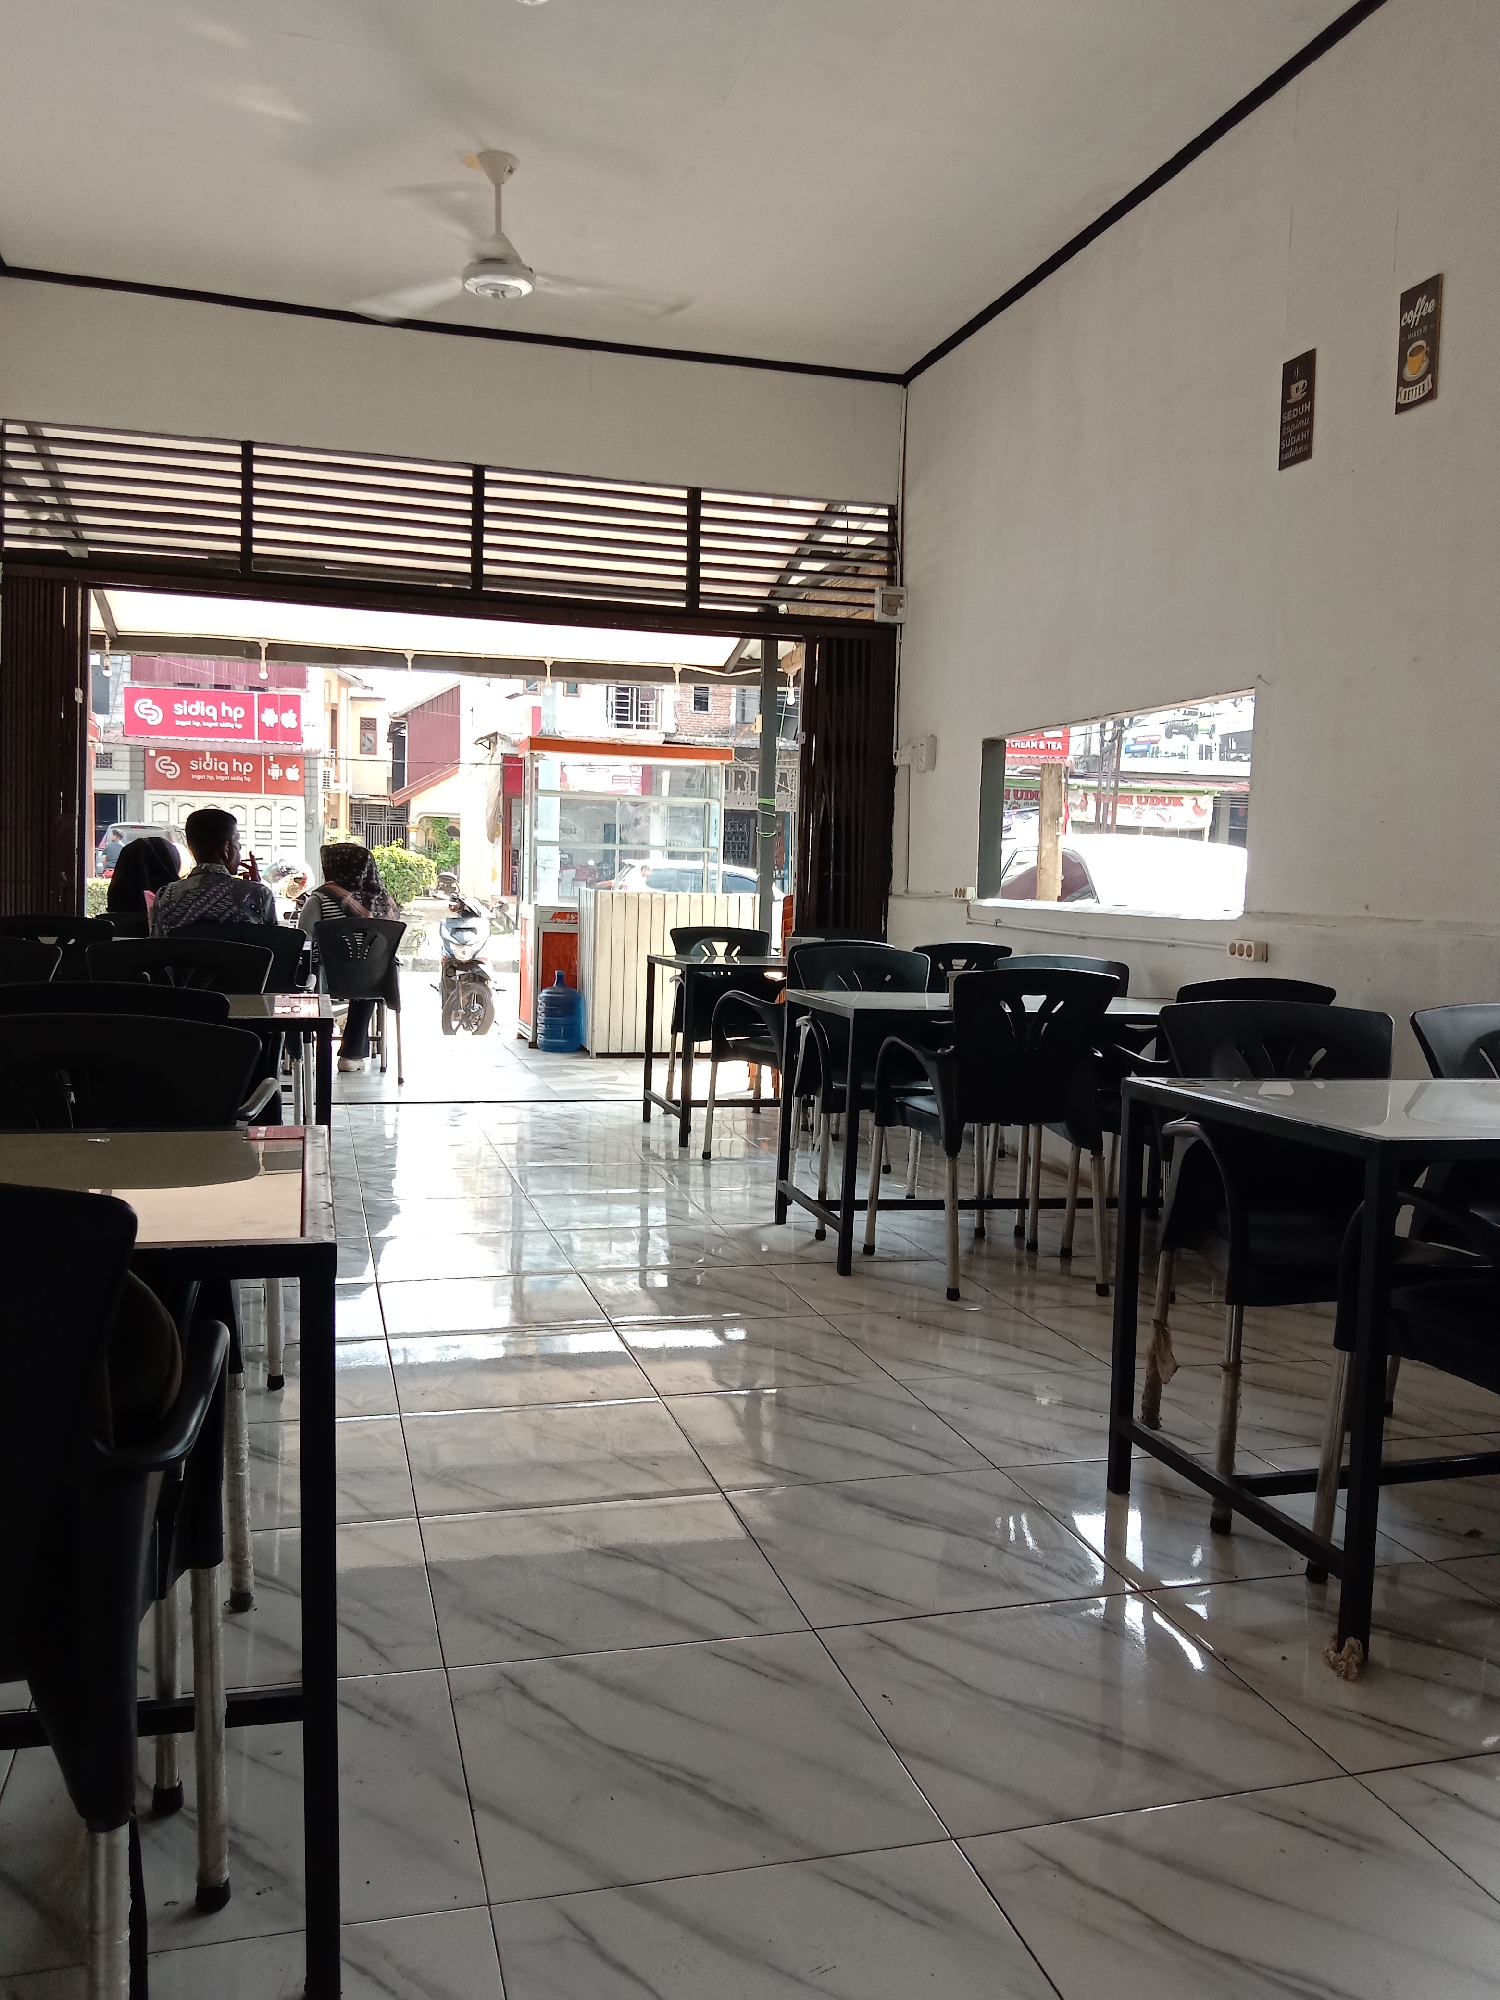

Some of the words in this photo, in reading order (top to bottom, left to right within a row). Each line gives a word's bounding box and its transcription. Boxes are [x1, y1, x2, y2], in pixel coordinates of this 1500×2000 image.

[1401, 294, 1436, 329] coffee
[1282, 401, 1311, 423] SEDUH
[173, 699, 218, 722] sidiq
[221, 701, 246, 722] hp
[1046, 741, 1063, 751] TEA
[189, 757, 229, 775] sidiq
[232, 758, 254, 776] hp
[1136, 795, 1184, 807] UDUK
